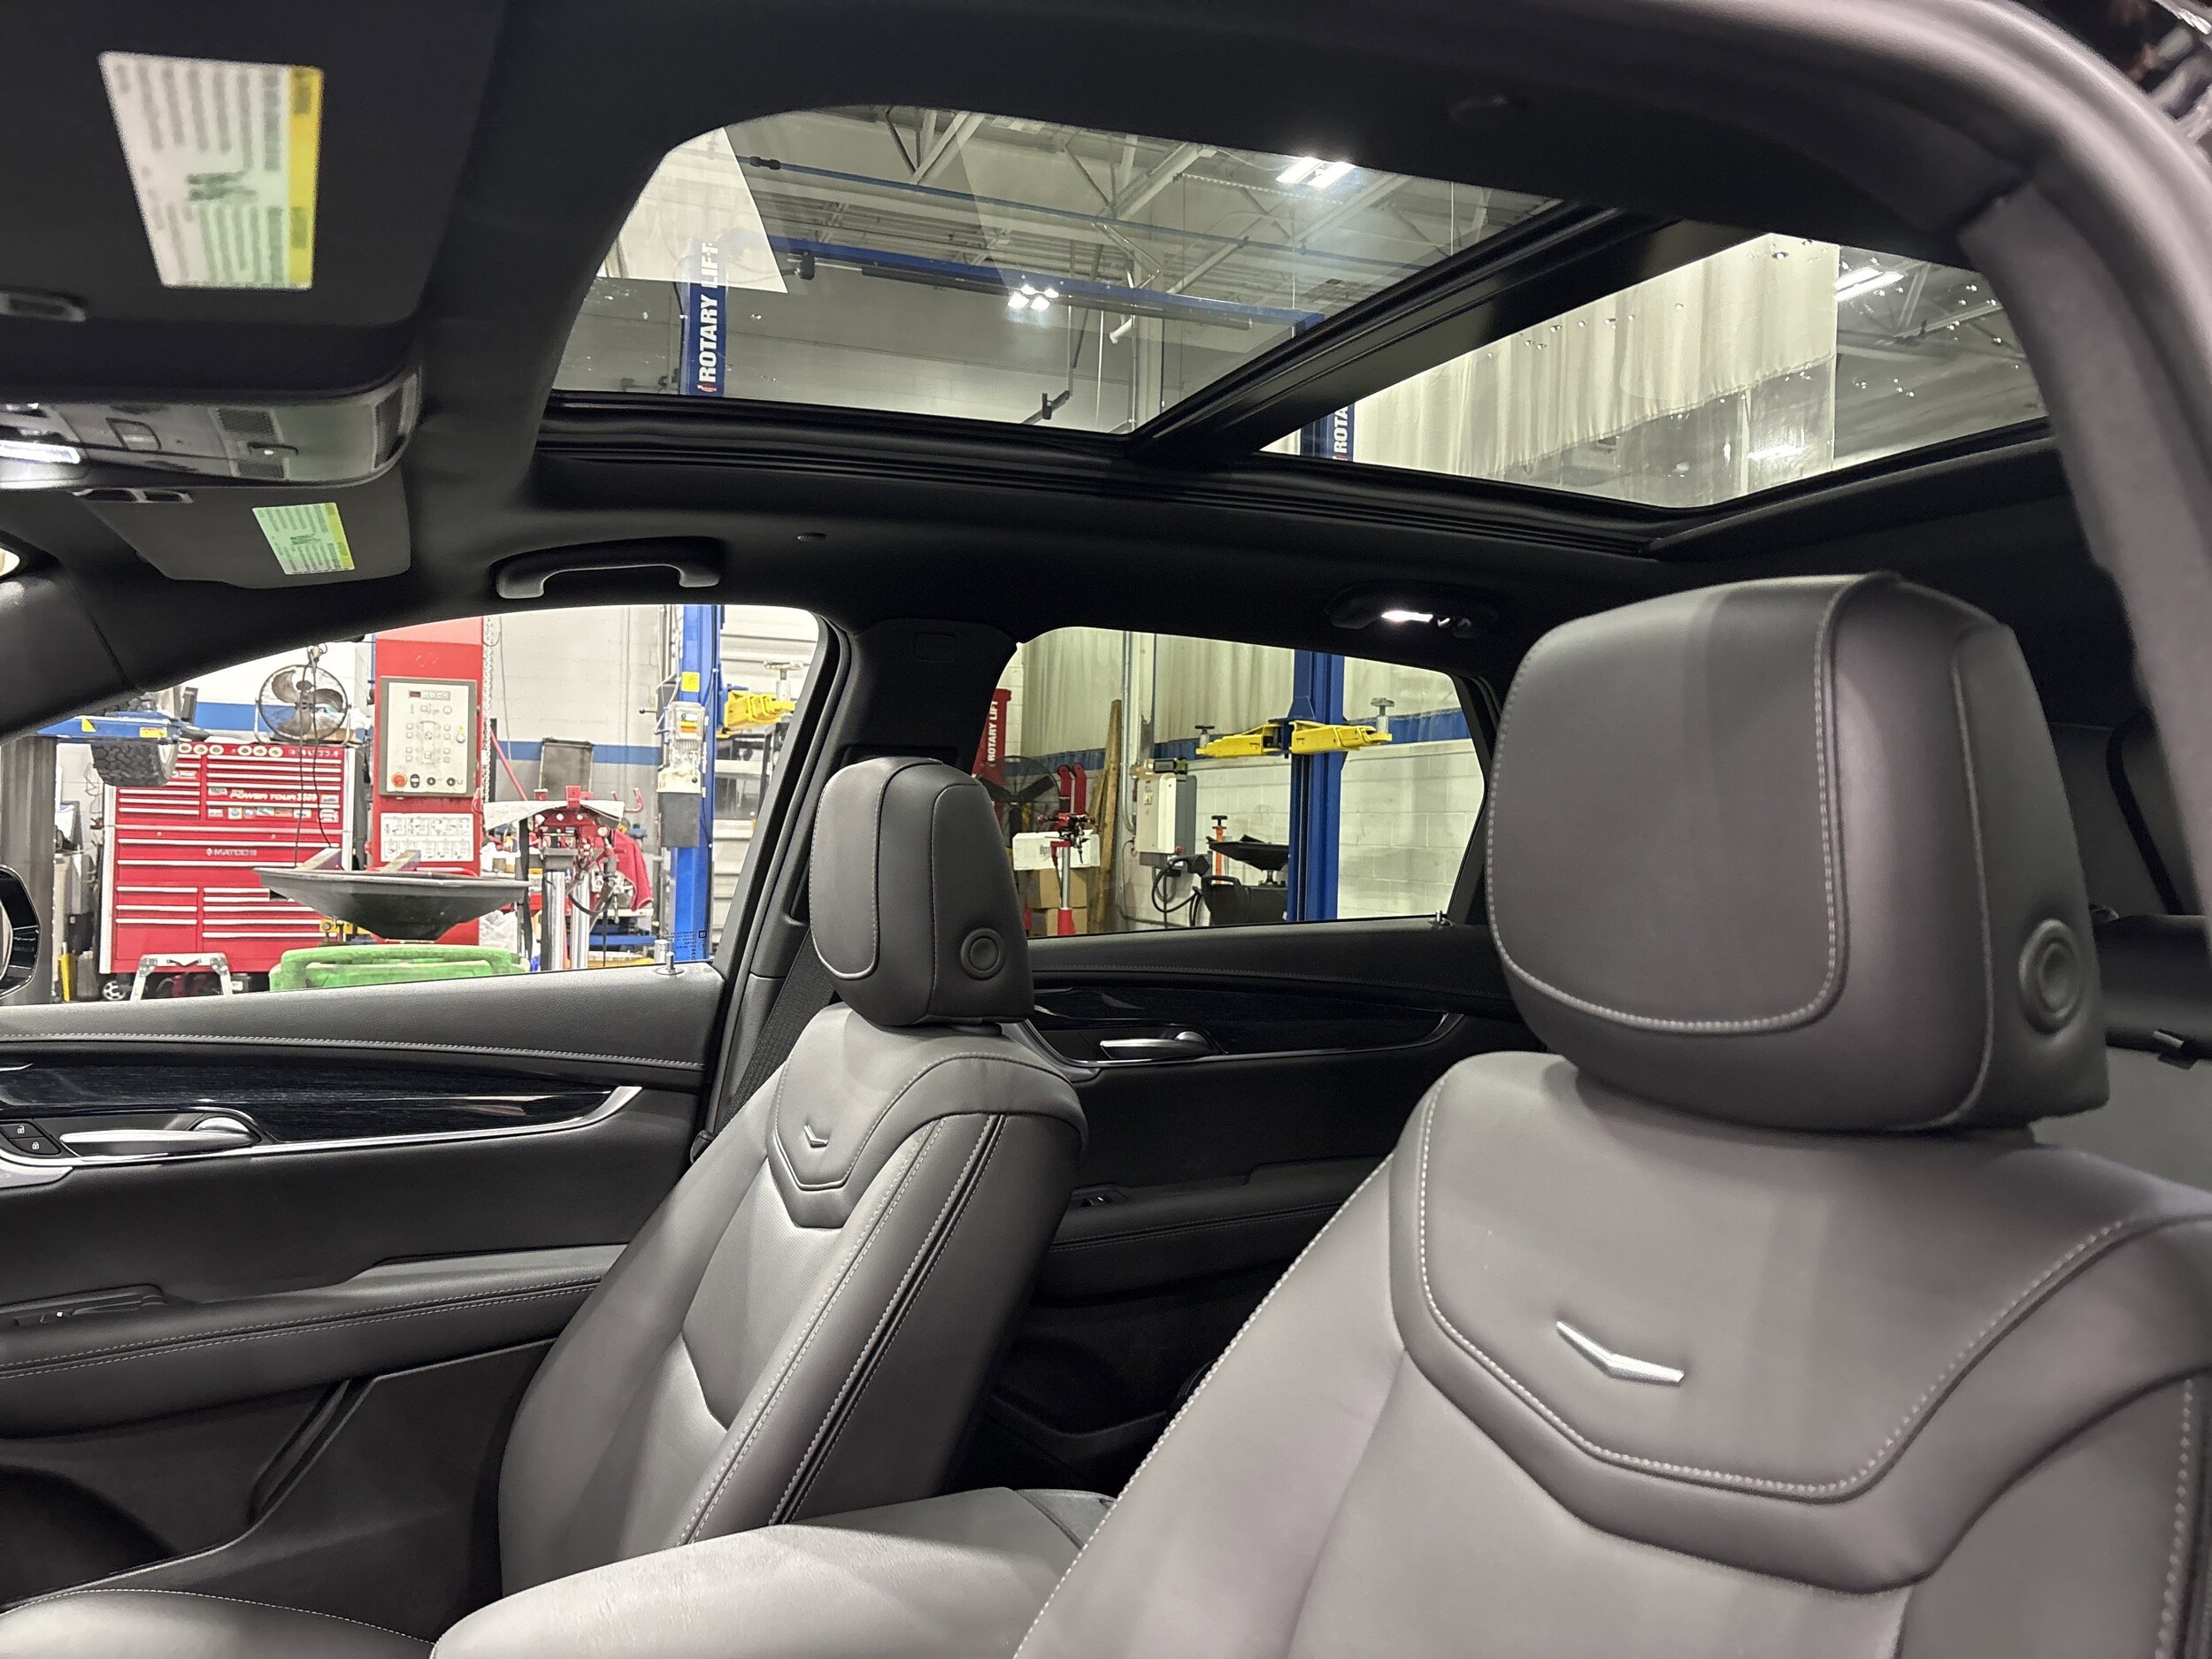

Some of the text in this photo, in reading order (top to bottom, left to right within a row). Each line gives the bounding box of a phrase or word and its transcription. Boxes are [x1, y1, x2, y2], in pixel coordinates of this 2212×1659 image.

[699, 242, 718, 383] ROTARY LIFT
[1333, 406, 1348, 453] ROTA
[987, 701, 998, 762] ROTARY LIFT
